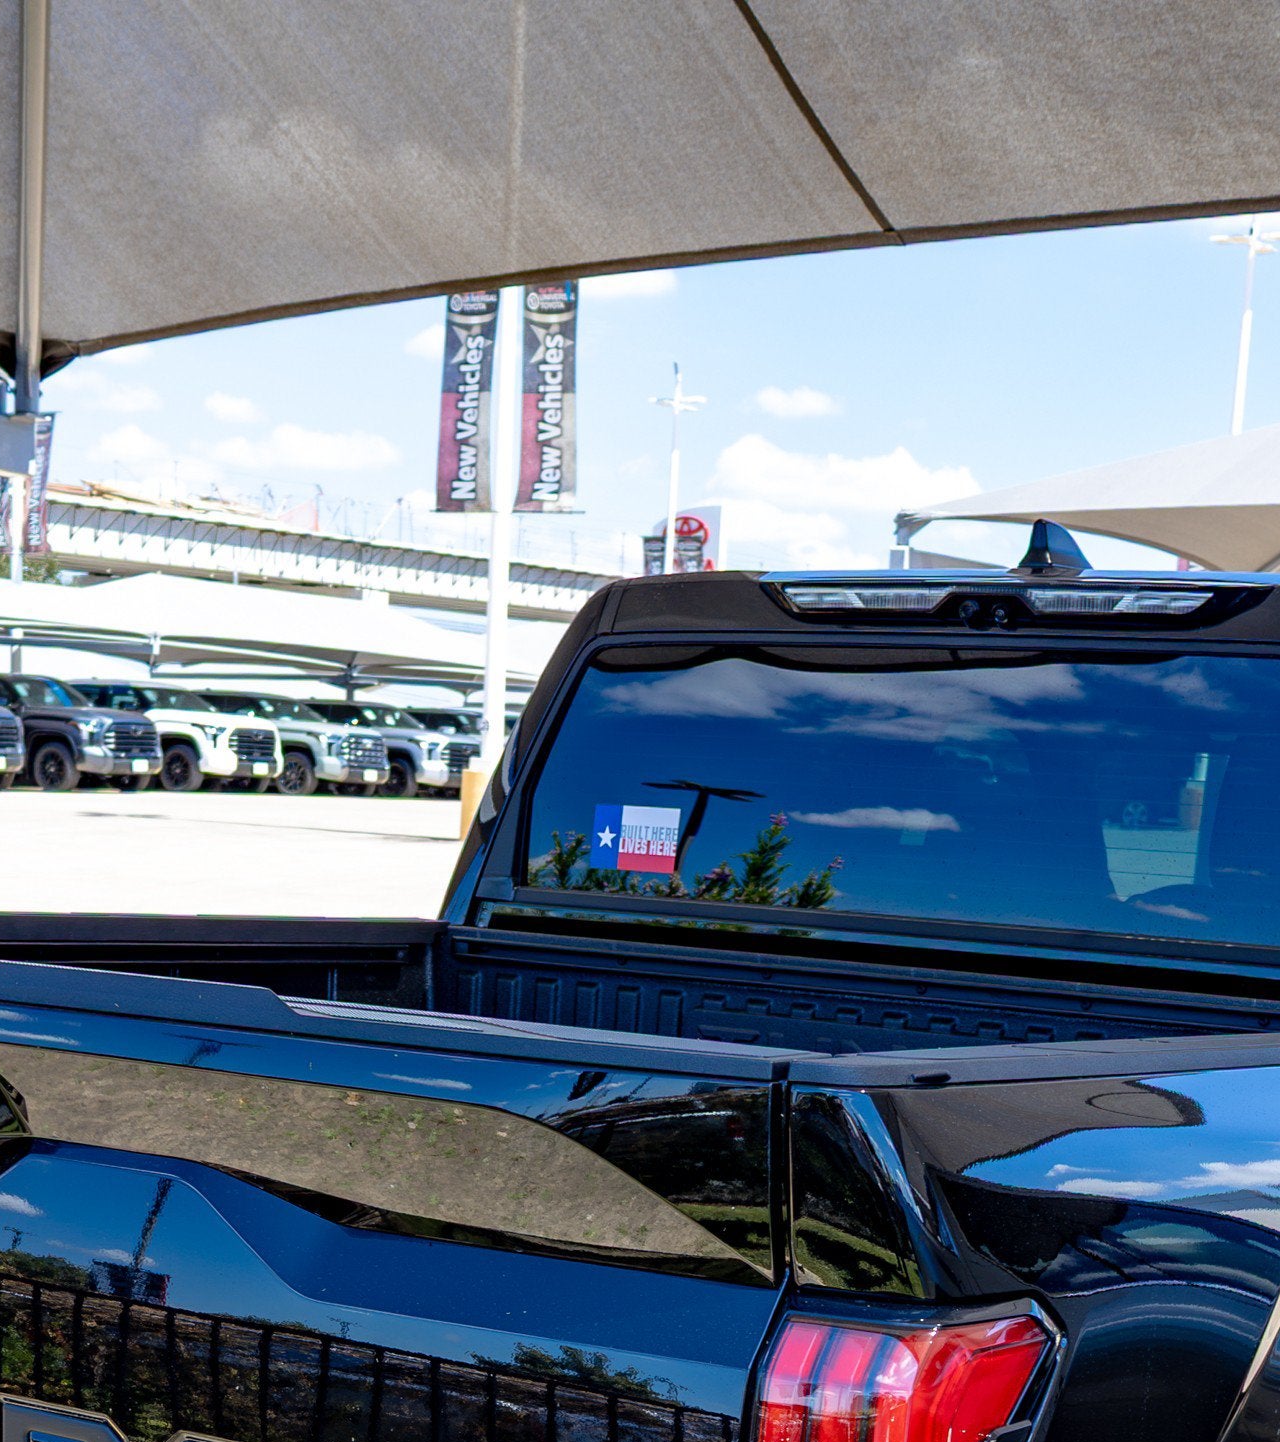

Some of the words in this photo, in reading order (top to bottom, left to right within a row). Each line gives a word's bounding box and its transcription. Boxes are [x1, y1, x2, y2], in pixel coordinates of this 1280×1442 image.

[456, 335, 485, 440] Vehicles
[538, 333, 564, 442] Vehicles
[450, 443, 477, 500] New
[532, 444, 562, 502] New
[28, 512, 42, 546] New
[618, 838, 649, 855] LIVES
[649, 840, 677, 857] HERE
[621, 825, 650, 841] BUILT
[651, 826, 678, 842] HERE
